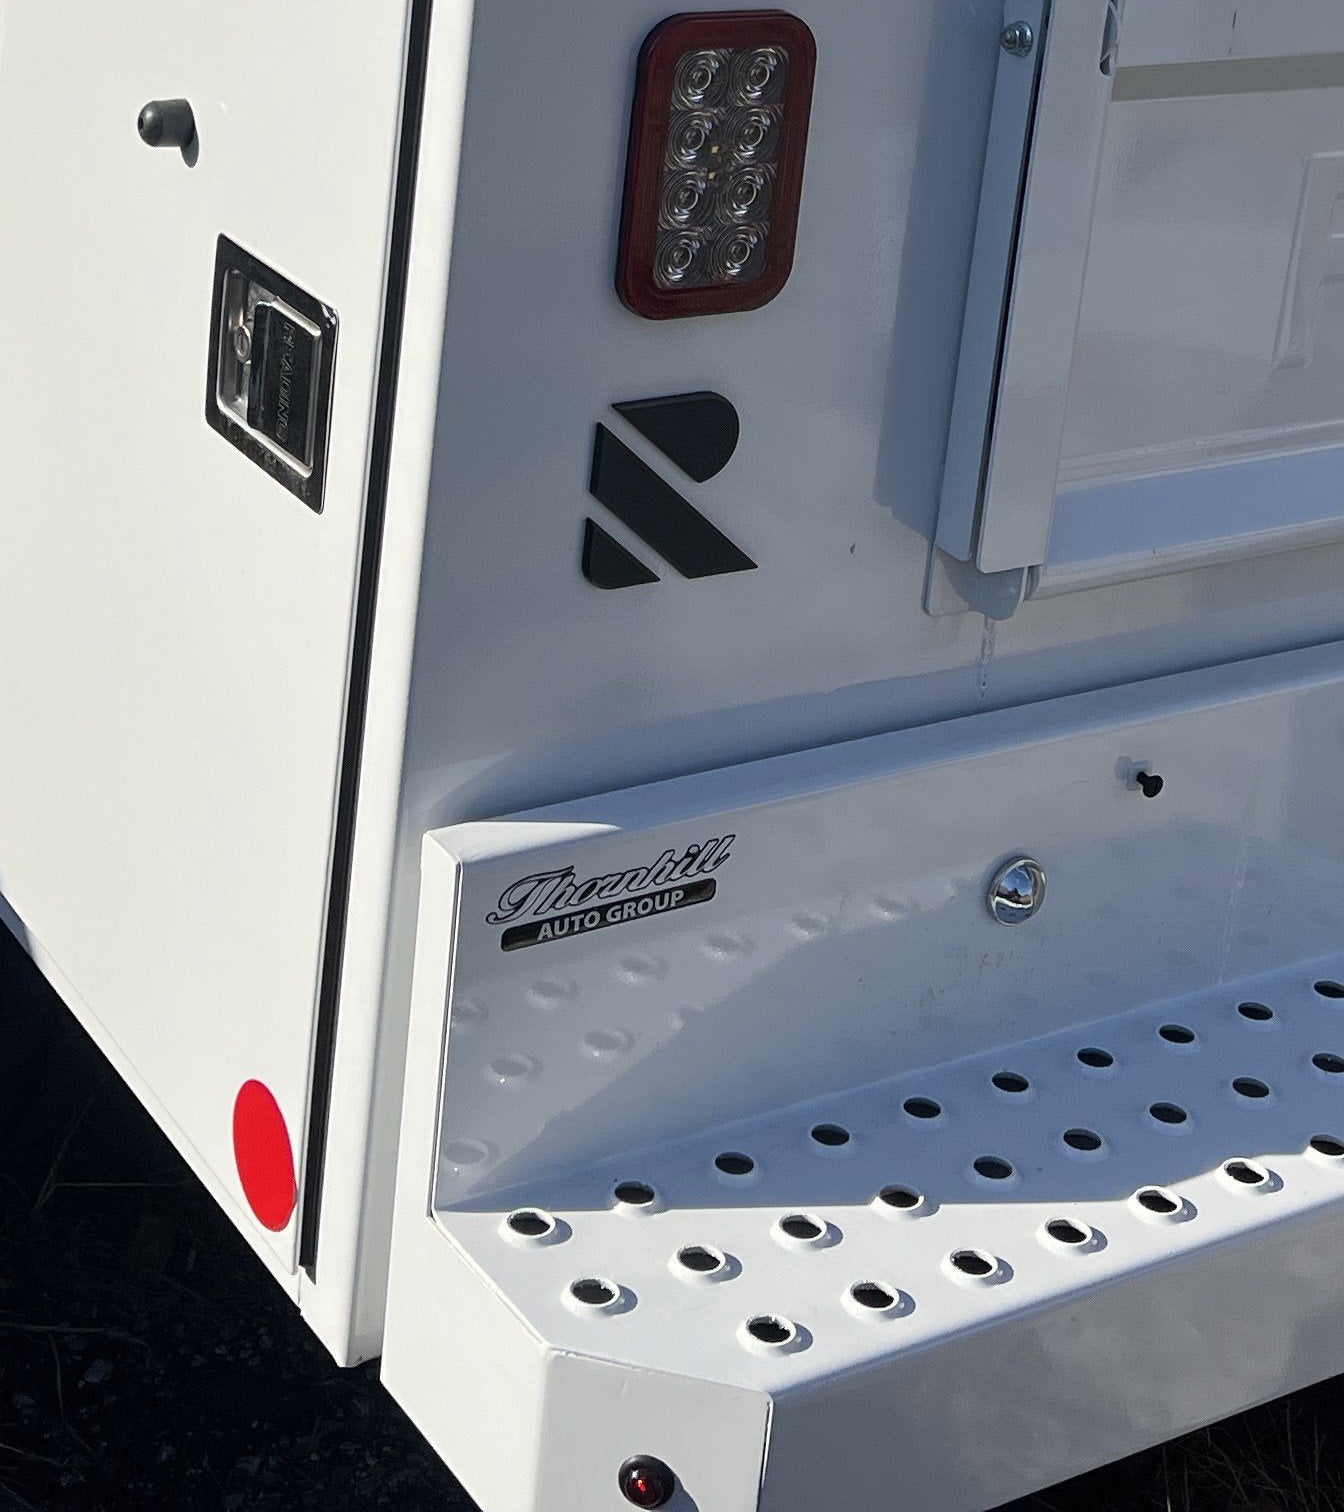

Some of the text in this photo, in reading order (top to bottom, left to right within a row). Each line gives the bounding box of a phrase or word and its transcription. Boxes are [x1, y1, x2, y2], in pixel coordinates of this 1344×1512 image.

[486, 834, 736, 925] Thornhill
[536, 889, 685, 942] AUTO GROUP
